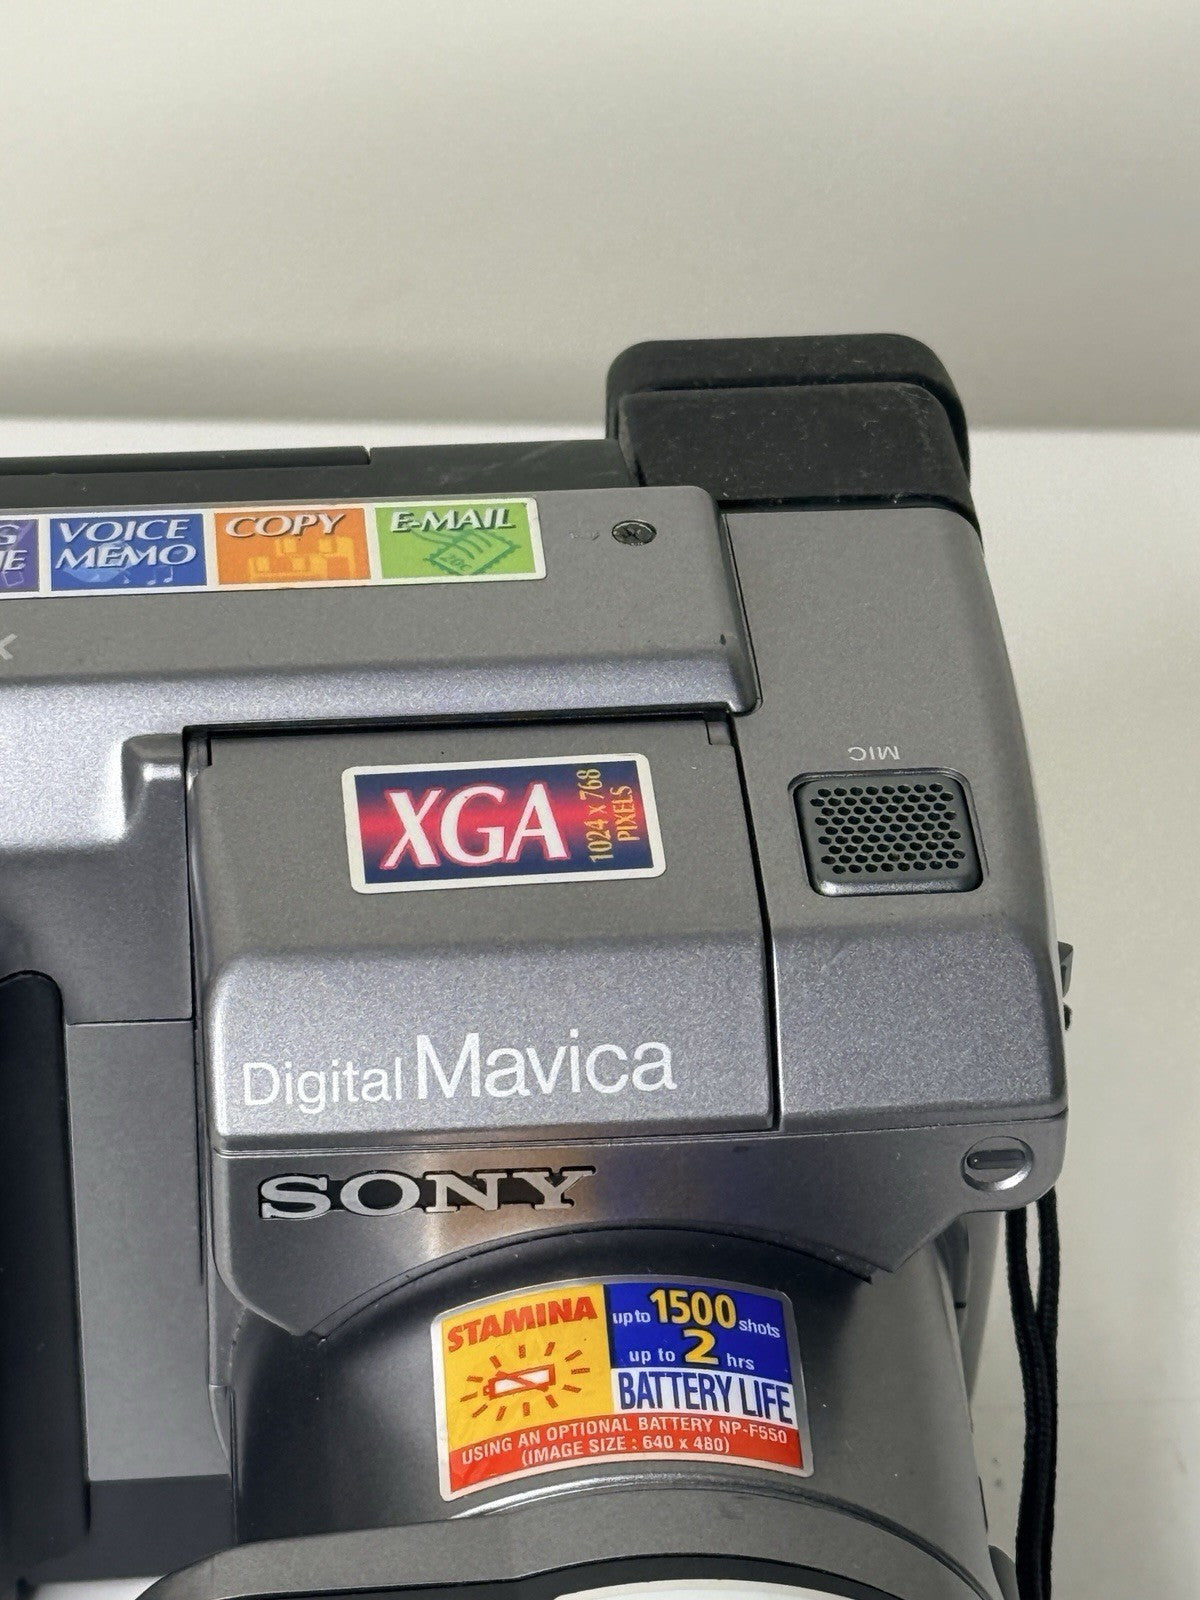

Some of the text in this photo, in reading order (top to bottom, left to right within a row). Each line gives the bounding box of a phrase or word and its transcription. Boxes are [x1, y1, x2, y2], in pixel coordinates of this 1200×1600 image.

[58, 517, 190, 543] VOICE
[225, 512, 346, 538] COPY
[390, 508, 516, 532] E-MAIL
[55, 543, 196, 570] MEMO
[848, 745, 900, 761] MIC
[576, 768, 605, 800] 768
[382, 783, 569, 868] XGA
[609, 785, 641, 842] PIXELS
[584, 818, 614, 863] 1024
[242, 1028, 677, 1114] Digital Mavica
[259, 1166, 597, 1220] SONY
[447, 1295, 598, 1352] STAMINA
[650, 1289, 737, 1329] 1500
[739, 1318, 781, 1339] shots
[629, 1328, 755, 1371] up to 2 hrs
[618, 1371, 793, 1424] BATTERY LIFE
[462, 1416, 788, 1465] USING AN OPTIONAL BATTERY NP-F550
[521, 1441, 584, 1466] (IMAGE
[589, 1435, 627, 1454] SIZE
[642, 1435, 674, 1450] 640
[693, 1436, 730, 1453] 480)
